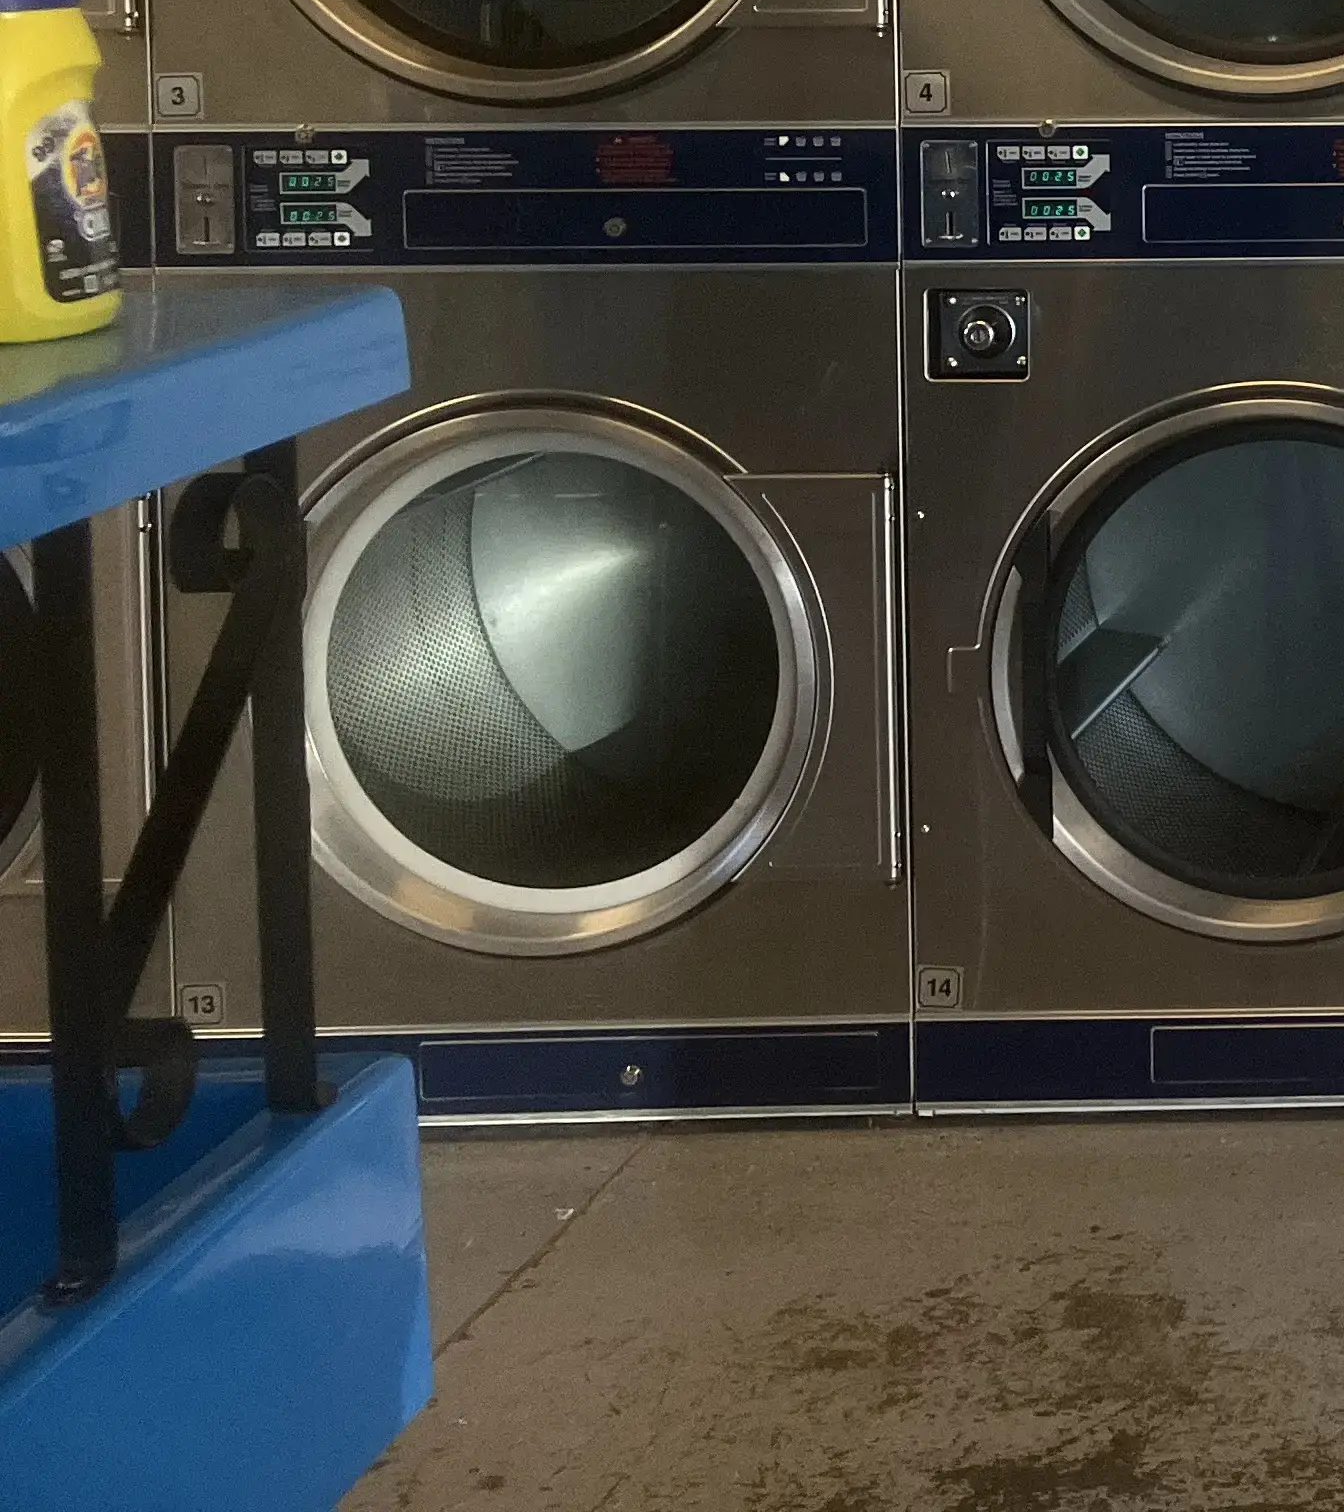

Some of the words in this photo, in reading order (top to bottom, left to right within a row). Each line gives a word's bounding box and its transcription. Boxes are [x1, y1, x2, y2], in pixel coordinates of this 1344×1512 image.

[171, 87, 185, 106] 3
[919, 83, 933, 102] 4
[926, 977, 952, 998] 14
[188, 995, 215, 1016] 13
